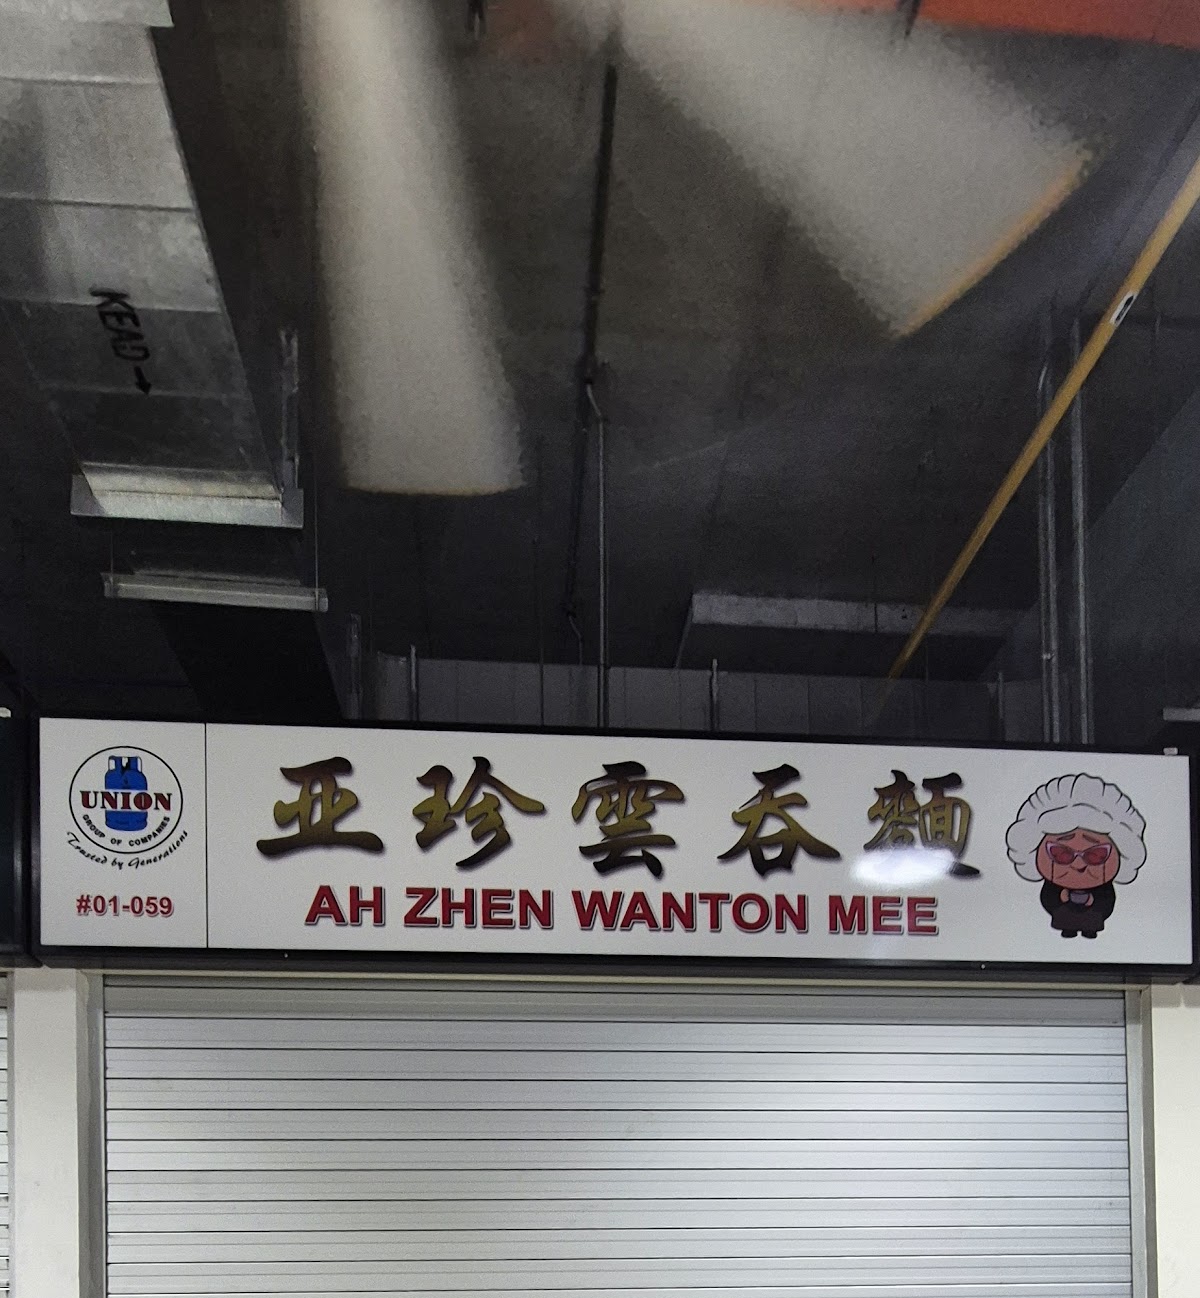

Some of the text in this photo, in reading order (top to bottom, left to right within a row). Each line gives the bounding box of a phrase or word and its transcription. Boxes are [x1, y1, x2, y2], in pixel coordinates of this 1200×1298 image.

[80, 790, 172, 811] UNION
[82, 814, 170, 847] GROUP OF COMPANIES
[66, 830, 188, 870] Trusted by Generations
[76, 895, 174, 917] #01-059
[305, 884, 939, 935] AH ZHEN WANTON MEE
